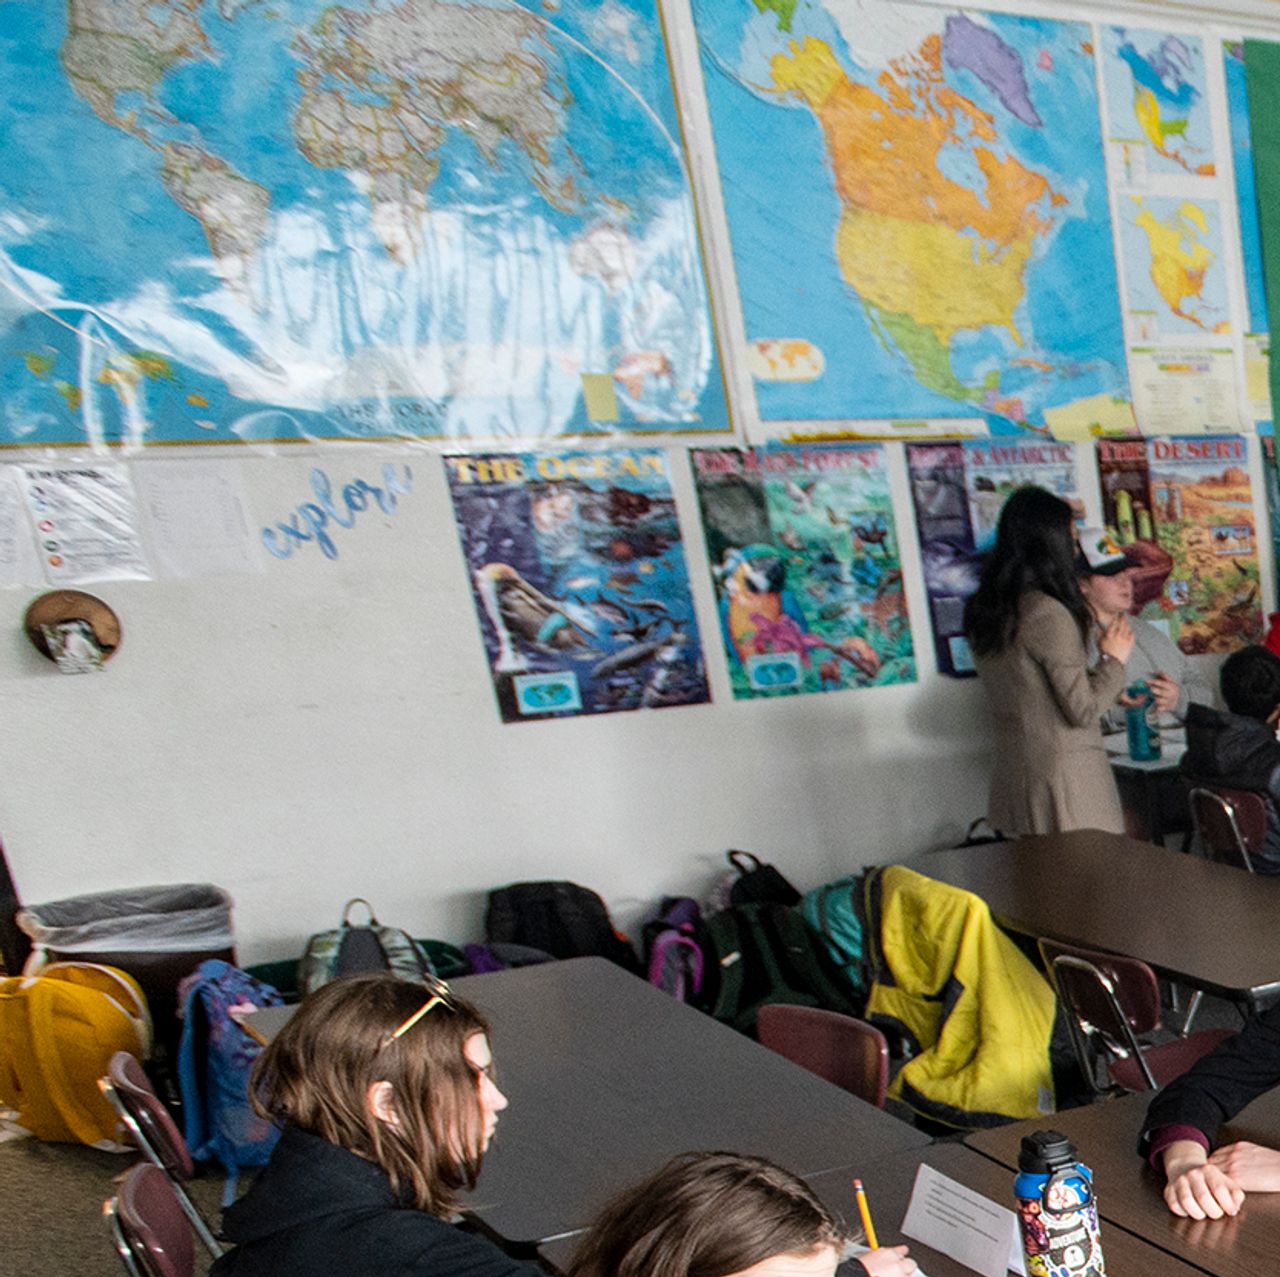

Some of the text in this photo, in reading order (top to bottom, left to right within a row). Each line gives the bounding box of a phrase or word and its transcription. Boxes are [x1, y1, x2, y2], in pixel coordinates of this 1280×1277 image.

[987, 445, 1073, 466] ANTARCTIC
[1099, 440, 1147, 461] THE
[1152, 439, 1243, 460] DESERT
[455, 451, 663, 484] THE OCEAN
[259, 463, 414, 561] explore
